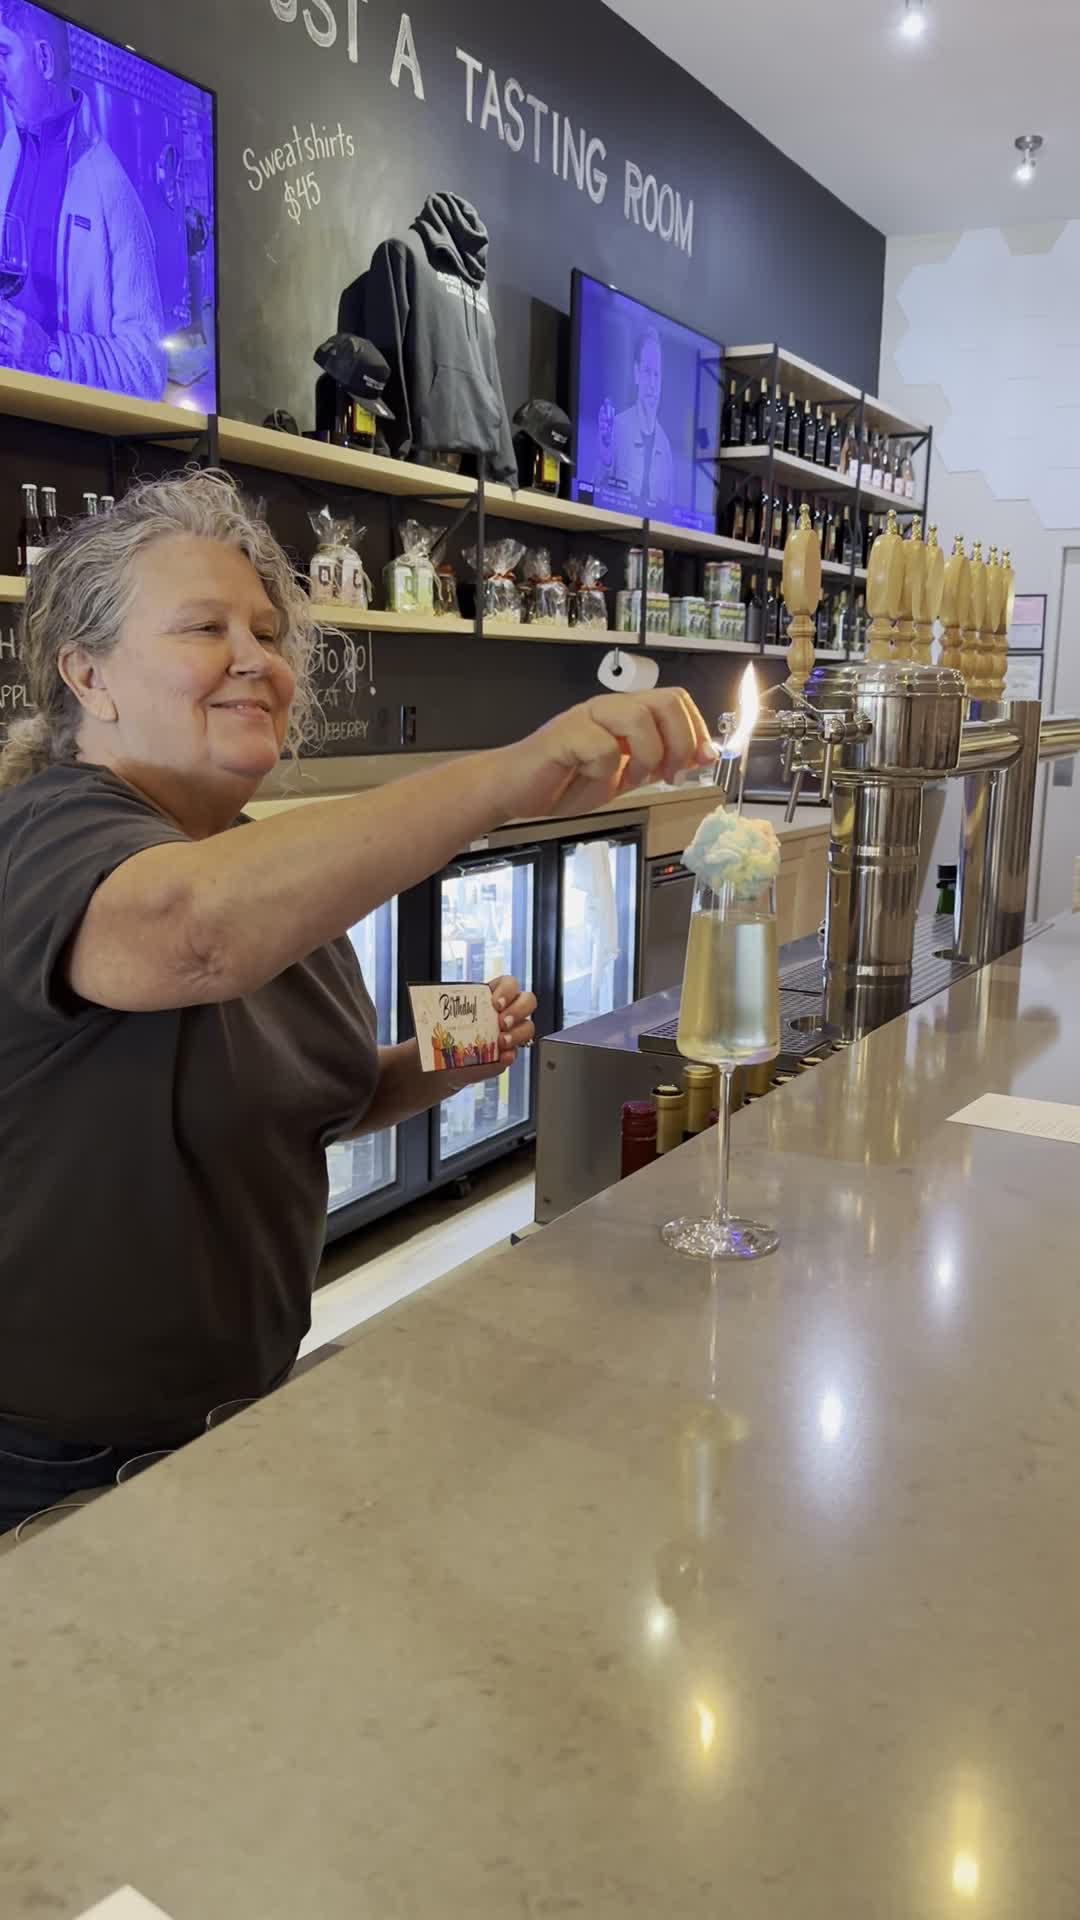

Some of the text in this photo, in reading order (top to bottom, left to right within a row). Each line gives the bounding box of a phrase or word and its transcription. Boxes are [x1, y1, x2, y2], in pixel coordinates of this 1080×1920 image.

[243, 122, 355, 191] Sweatshirts
[390, 12, 425, 100] A
[456, 46, 607, 204] TASTING
[624, 159, 694, 257] ROOM
[284, 171, 321, 225] $45
[316, 629, 339, 673] to
[439, 993, 478, 1023] Birthday!
